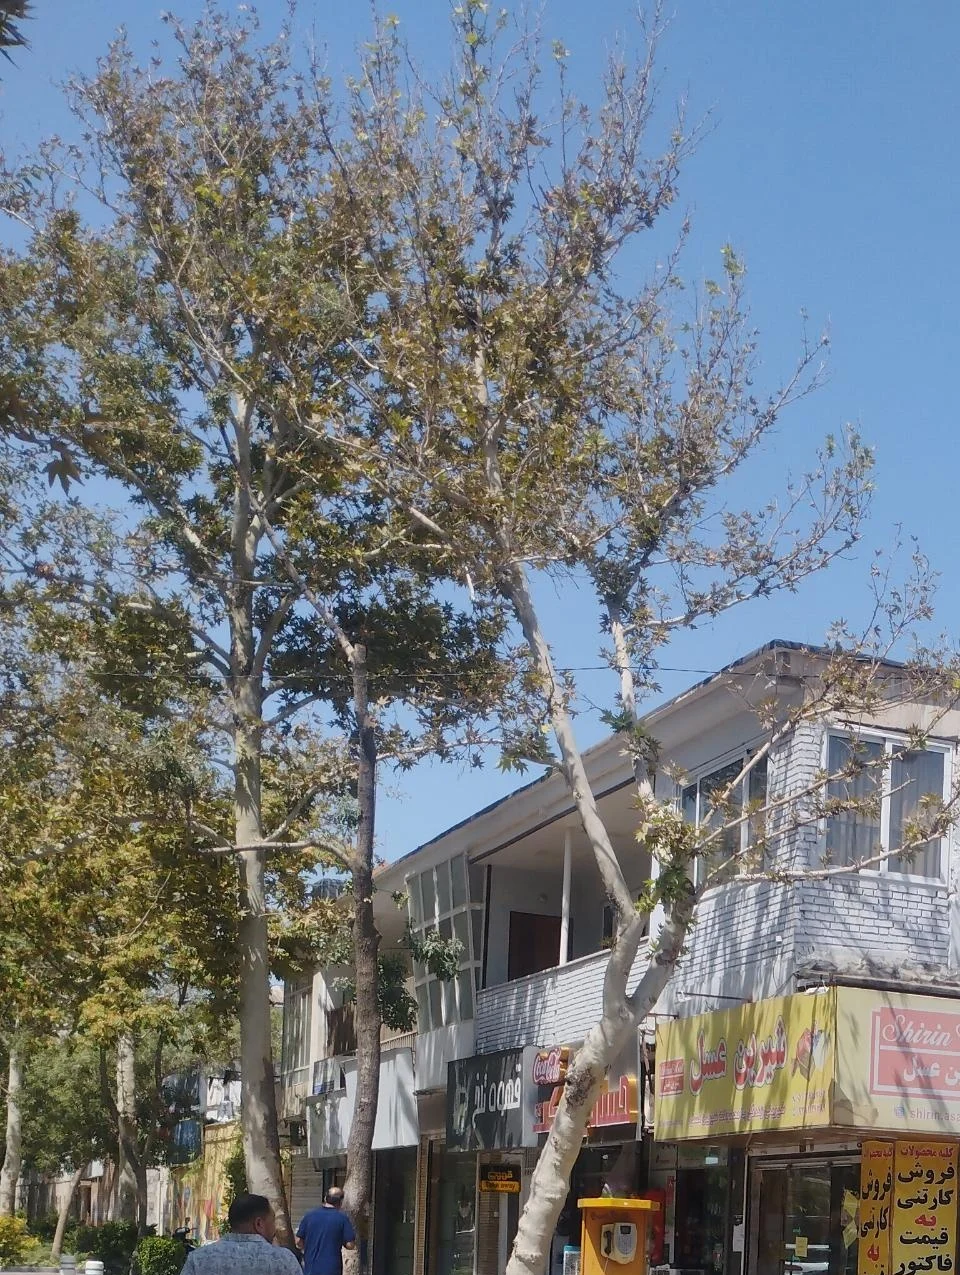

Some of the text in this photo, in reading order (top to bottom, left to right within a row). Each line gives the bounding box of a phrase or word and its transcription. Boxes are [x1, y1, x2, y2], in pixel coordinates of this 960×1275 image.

[882, 1014, 952, 1047] Shirin
[690, 1015, 787, 1096] شیرین عسل
[903, 1055, 941, 1082] عسل
[900, 1145, 953, 1160] کلیه محصولات
[862, 1166, 892, 1200] فروش
[898, 1162, 955, 1184] فروش
[897, 1189, 954, 1210] کارتنی
[861, 1205, 889, 1238] کارتنی
[915, 1214, 937, 1231] به
[899, 1227, 949, 1249] قیمت
[867, 1243, 880, 1261] به
[894, 1254, 953, 1275] فاکتور
